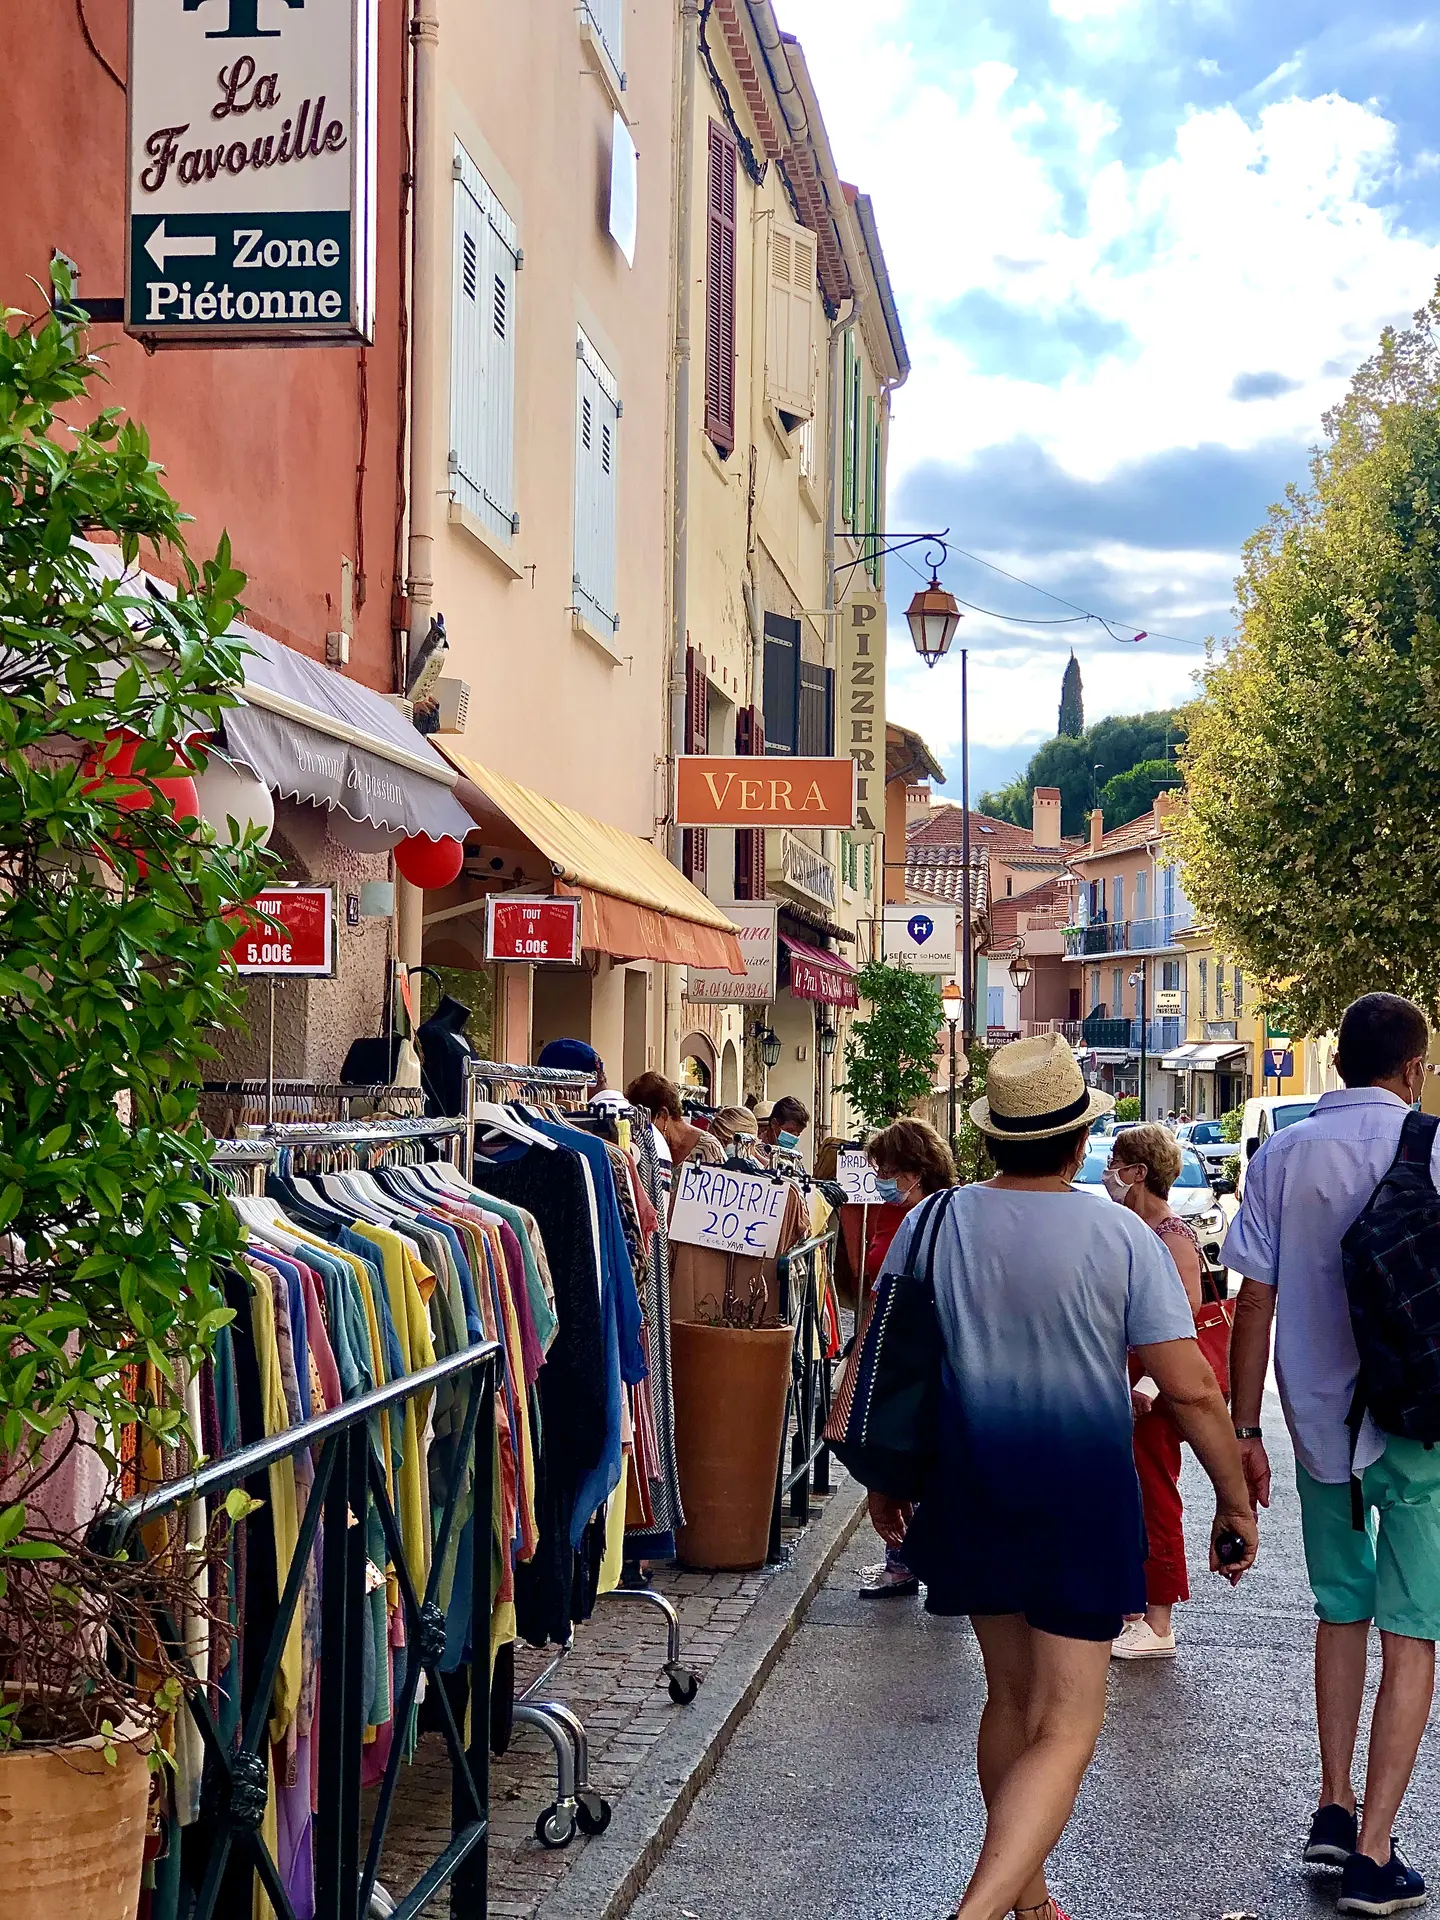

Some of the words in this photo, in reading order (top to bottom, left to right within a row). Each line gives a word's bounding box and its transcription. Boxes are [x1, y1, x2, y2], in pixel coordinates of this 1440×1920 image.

[211, 55, 281, 119] La
[140, 95, 348, 192] Favouille
[233, 229, 340, 268] Zone
[145, 281, 342, 321] Piétonne
[849, 604, 877, 830] PIZZERIA
[315, 751, 345, 785] mond
[700, 772, 830, 812] VERA
[255, 900, 282, 915] TOUT
[522, 908, 542, 920] TOUT
[527, 921, 534, 934] À
[738, 926, 772, 941] ara
[246, 943, 292, 965] 5,00€
[514, 939, 548, 955] 5,00€
[889, 952, 918, 960] SEECT
[928, 952, 952, 960] HOME
[680, 1168, 784, 1218] BRADERIE
[702, 1211, 739, 1239] 20
[744, 1221, 769, 1248] €
